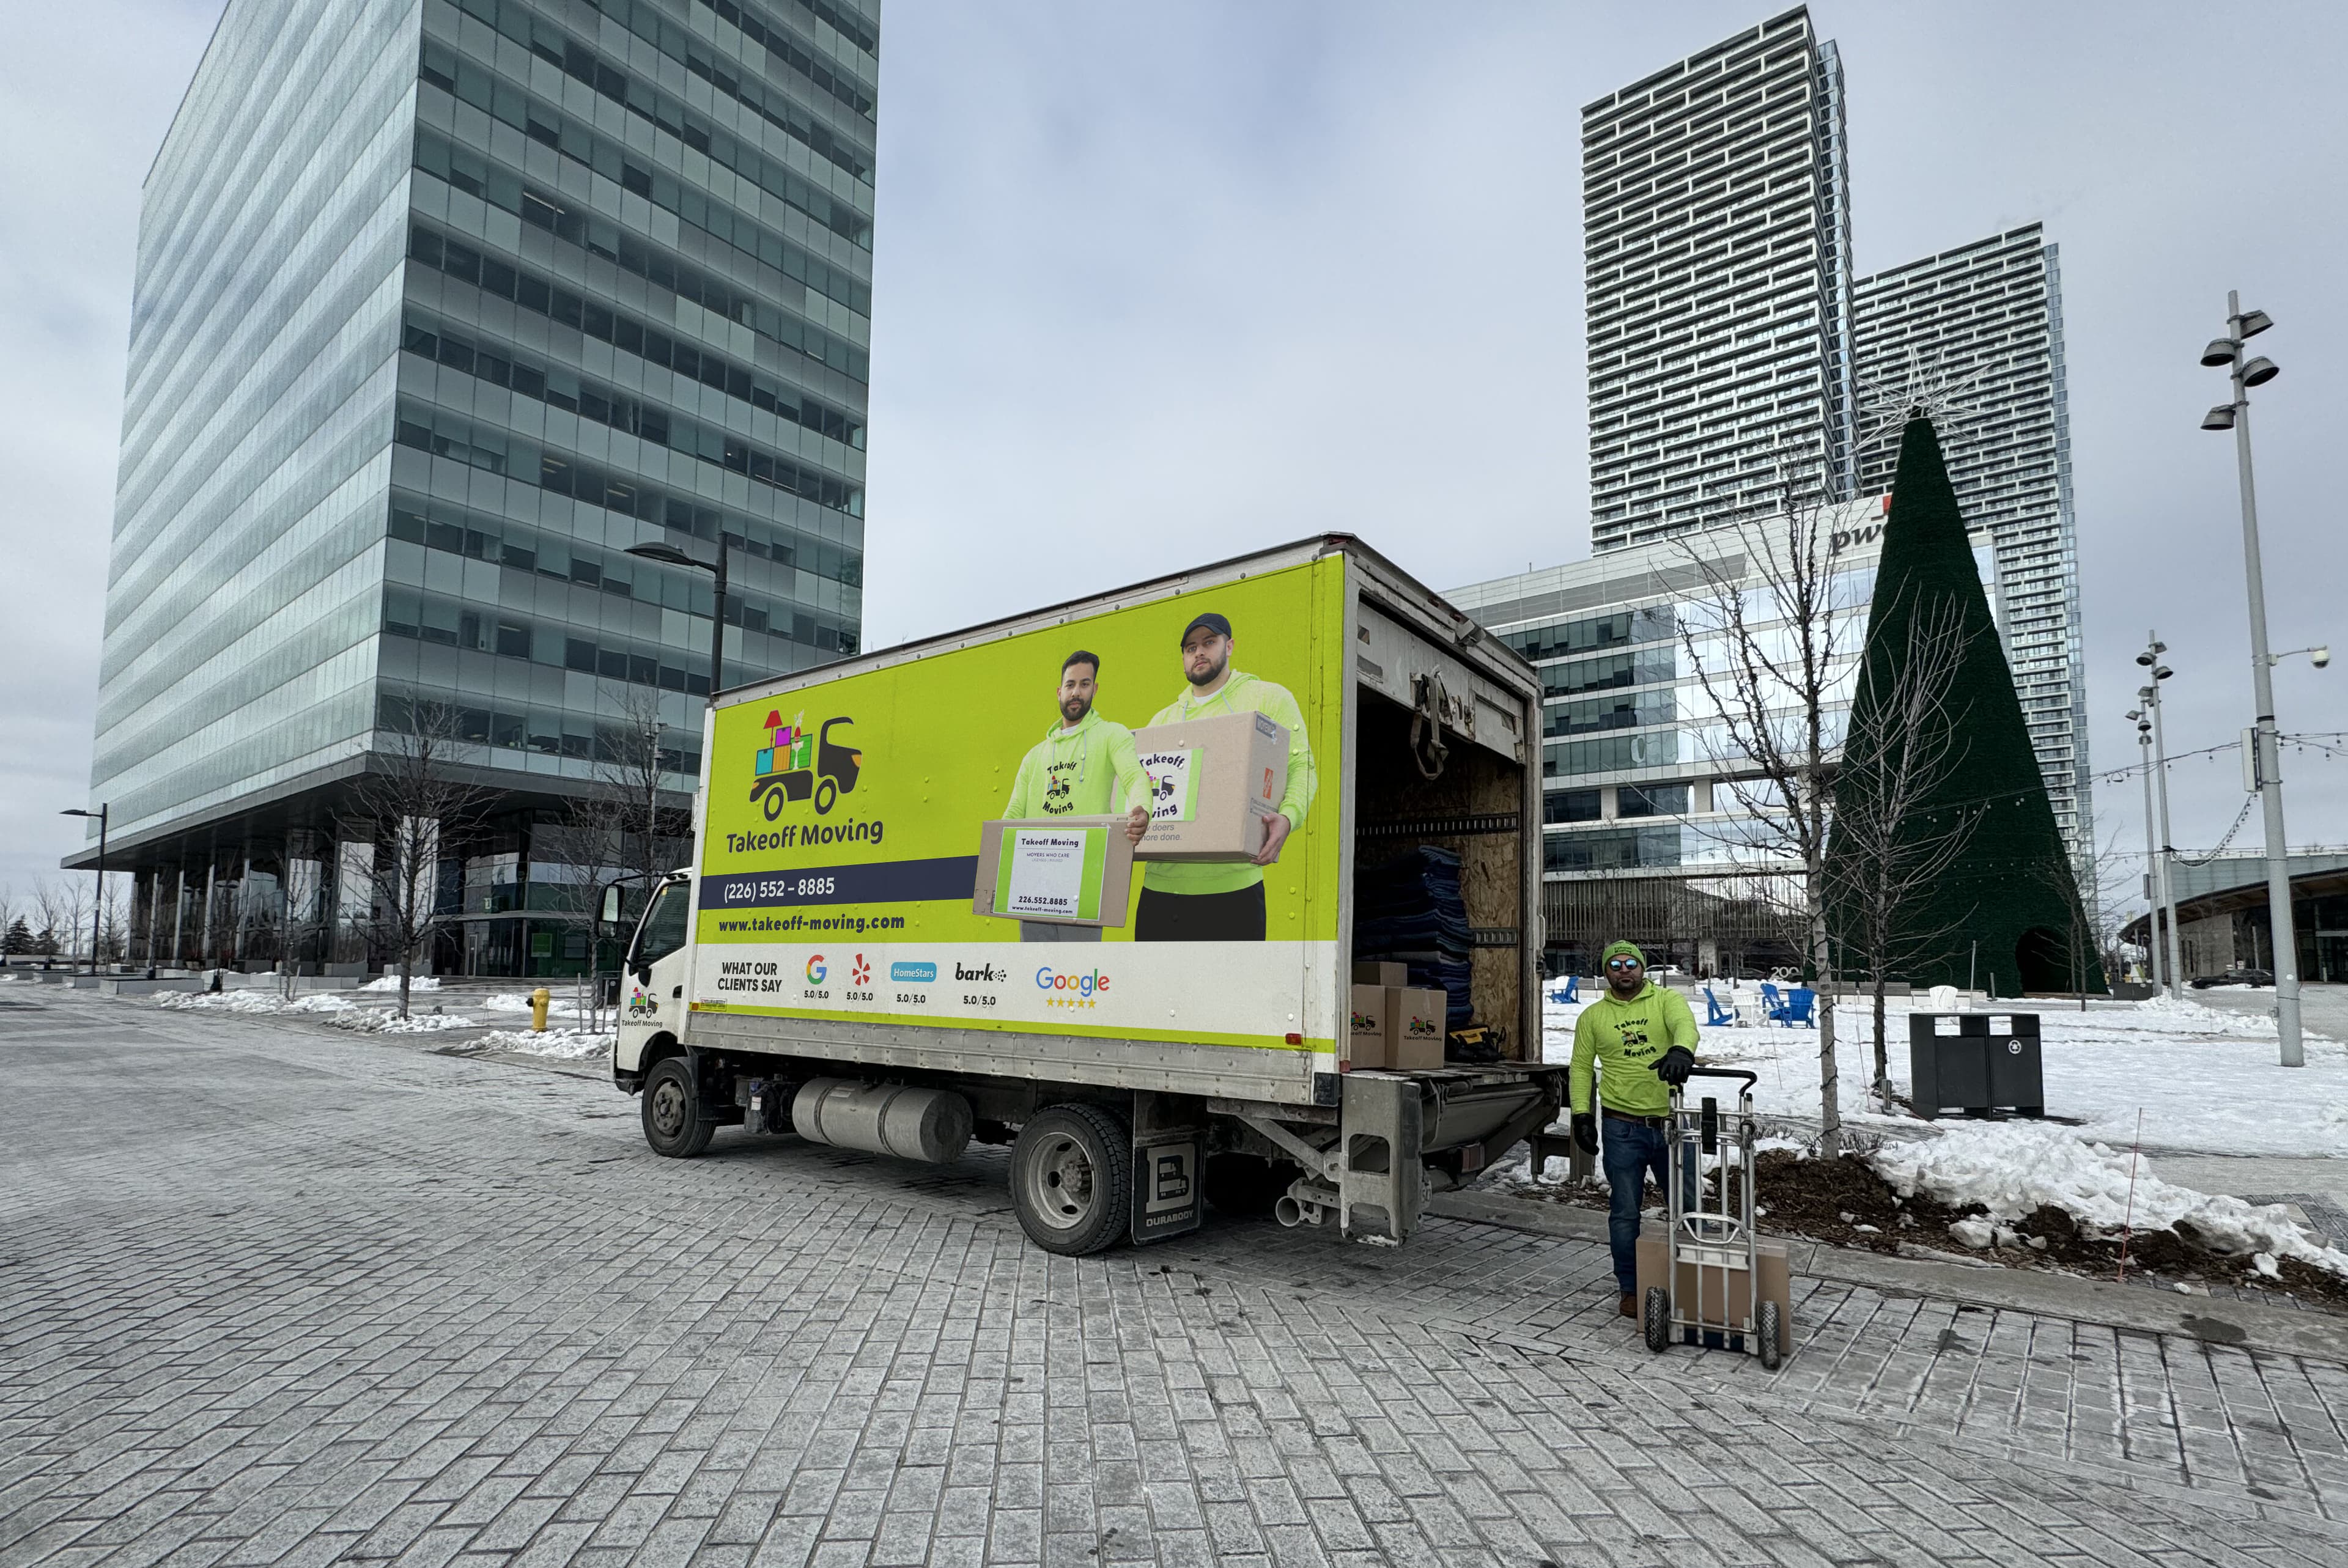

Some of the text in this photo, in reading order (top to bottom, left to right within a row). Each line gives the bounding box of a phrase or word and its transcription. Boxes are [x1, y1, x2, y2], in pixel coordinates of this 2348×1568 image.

[1831, 524, 1887, 556] pw
[1042, 801, 1074, 814] Moving
[1152, 804, 1178, 819] ving
[726, 817, 884, 853] Takeoff Moving
[1050, 838, 1079, 848] Moving
[724, 882, 756, 904] (226)
[759, 880, 785, 898] 552
[797, 877, 835, 896] 8885
[1018, 896, 1068, 906] 226.552.8885
[1012, 906, 1073, 915] www.takeoff-moving.com
[718, 914, 905, 933] www.takeoff-moving.com
[722, 962, 778, 976] WHAT OUR
[893, 968, 934, 978] HomeStars
[955, 962, 994, 981] bark
[718, 978, 783, 993] CLIENTS SAY
[1036, 966, 1110, 997] Google
[804, 990, 829, 999] 5.0/5.0
[846, 992, 873, 1001] 5.0/5.0
[896, 993, 926, 1004] 5.0/5.0
[963, 995, 996, 1006] 5.0/5.0
[642, 1020, 663, 1028] Moving
[1614, 1018, 1648, 1031] Takeoff
[1624, 1046, 1656, 1057] Moving
[1146, 1210, 1194, 1228] DURABODY
